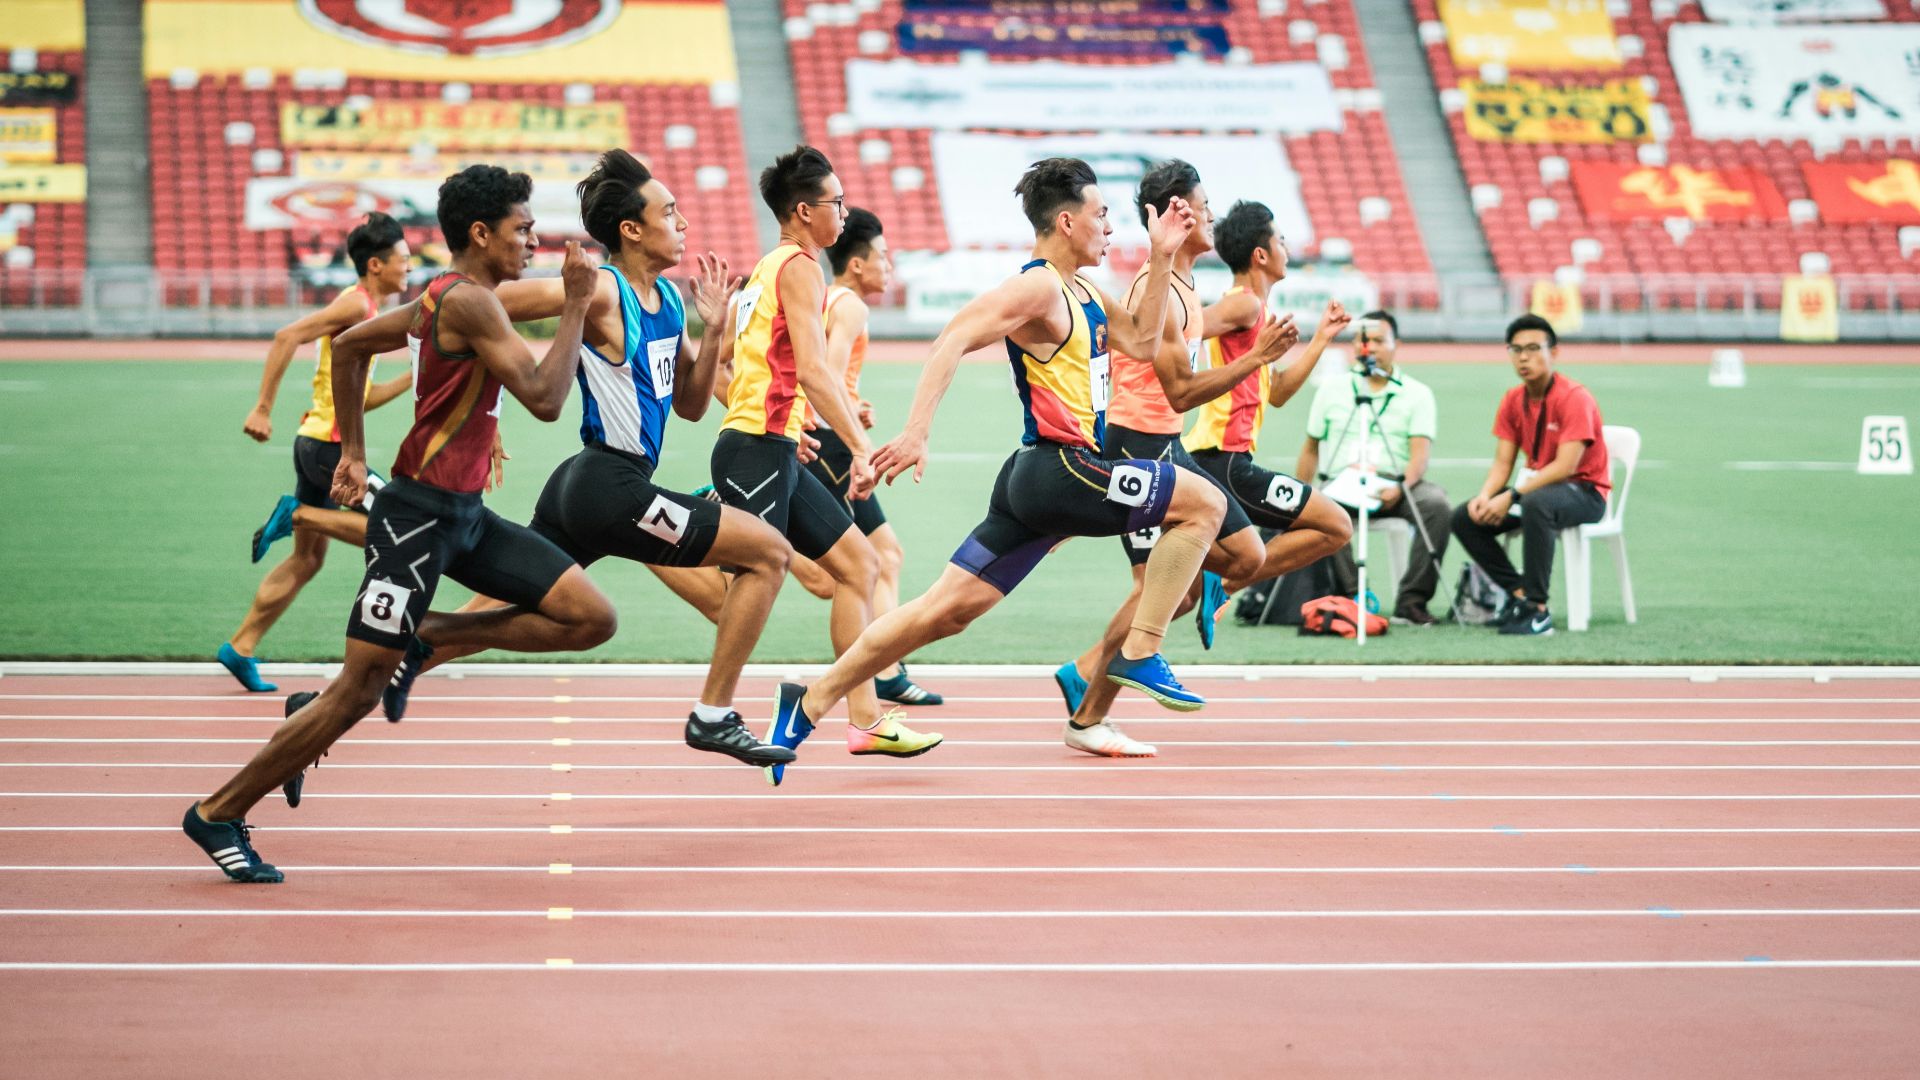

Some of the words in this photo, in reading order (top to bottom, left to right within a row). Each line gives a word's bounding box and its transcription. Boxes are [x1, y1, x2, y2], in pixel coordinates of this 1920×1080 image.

[1869, 426, 1901, 461] 55
[1118, 474, 1142, 496] 6
[1275, 484, 1294, 503] 3
[650, 506, 678, 532] 7
[370, 592, 395, 621] 8
